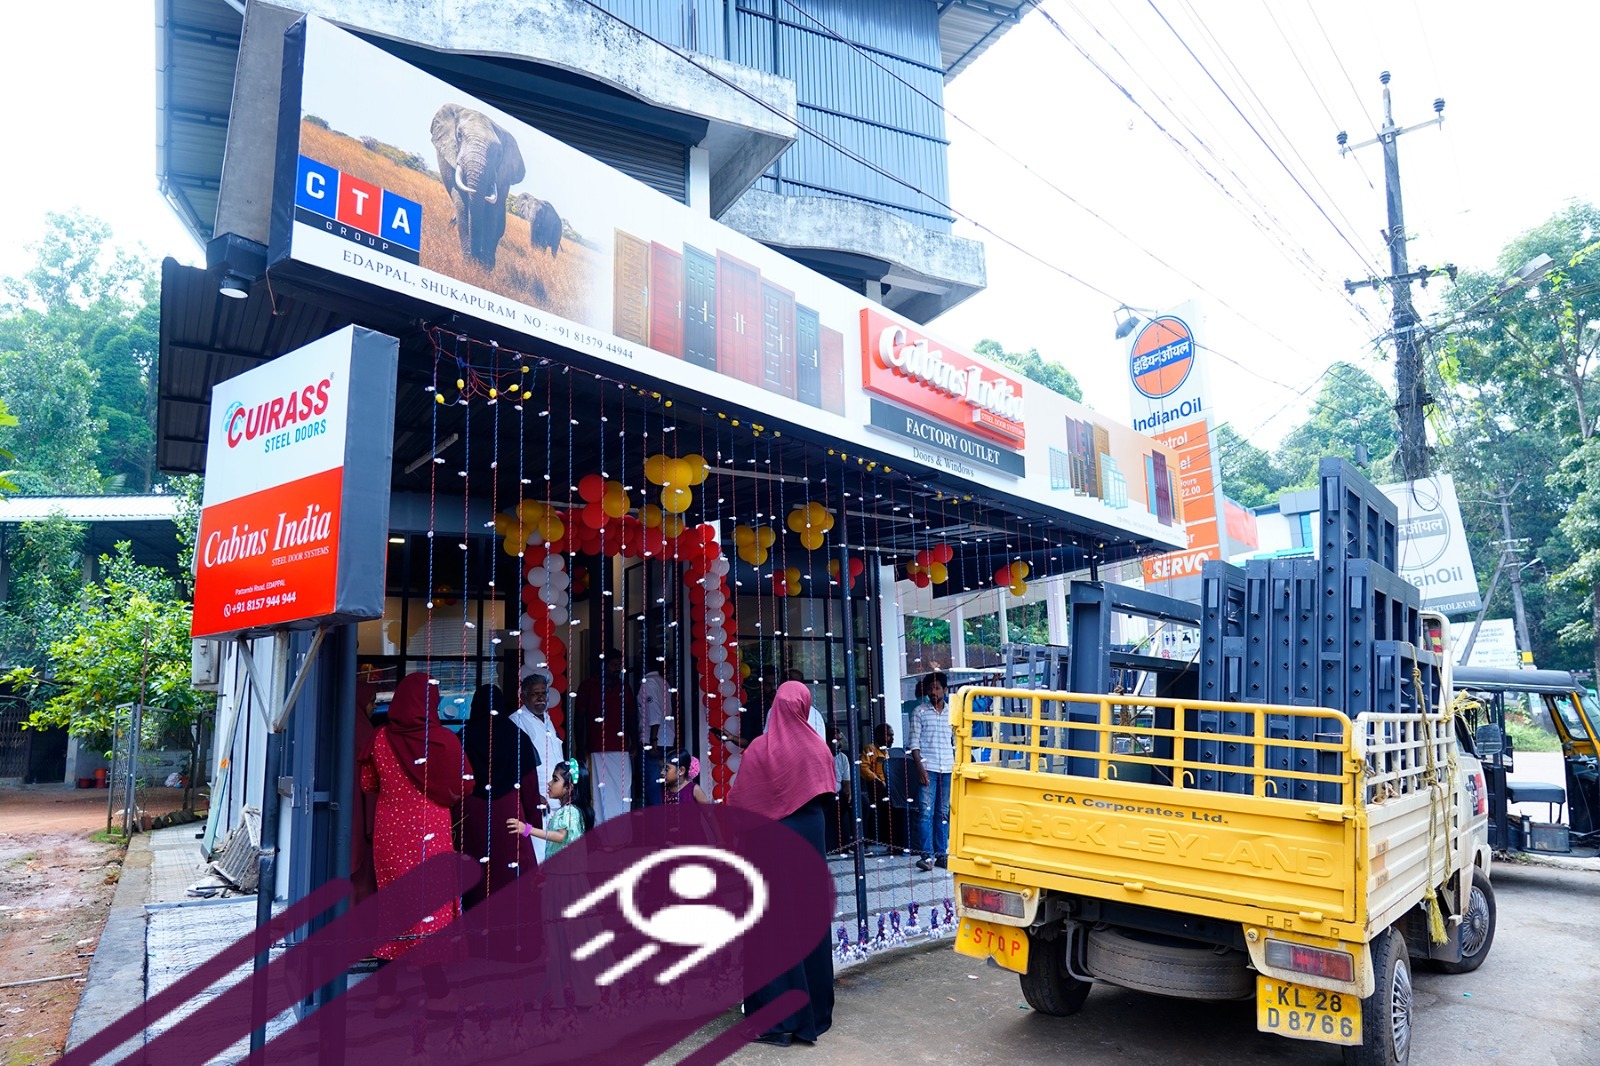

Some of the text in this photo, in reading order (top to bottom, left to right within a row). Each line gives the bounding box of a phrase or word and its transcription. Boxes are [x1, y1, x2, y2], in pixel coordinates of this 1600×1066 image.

[306, 171, 411, 235] CTA
[326, 221, 389, 251] GROUP
[343, 250, 416, 287] EDAPPAL,
[421, 278, 516, 320] SHUKAPURAM
[524, 314, 541, 328] NO
[552, 326, 569, 338] +91
[574, 331, 603, 349] 81579
[606, 343, 633, 360] 44944
[879, 325, 1024, 422] Cabins India
[227, 378, 331, 449] CUIRASS
[1133, 397, 1202, 431] IndianOil
[264, 419, 327, 453] STEEL DOORS
[906, 417, 1000, 465] FACTORY OUTLET
[1157, 431, 1188, 450] etrol
[913, 447, 974, 477] Doors & Windows
[204, 504, 332, 568] Cabins India
[271, 546, 330, 566] STEEL DOOR SYSTEMS
[1152, 552, 1209, 579] SERVO
[232, 591, 297, 614] +91 8157 944 944
[1042, 793, 1229, 824] CTA Corporates Ltd.
[972, 806, 1334, 878] ASHOK LEYLAND
[973, 927, 1021, 957] STOP
[1277, 986, 1342, 1012] KL 28
[1268, 1007, 1353, 1037] D 8766
